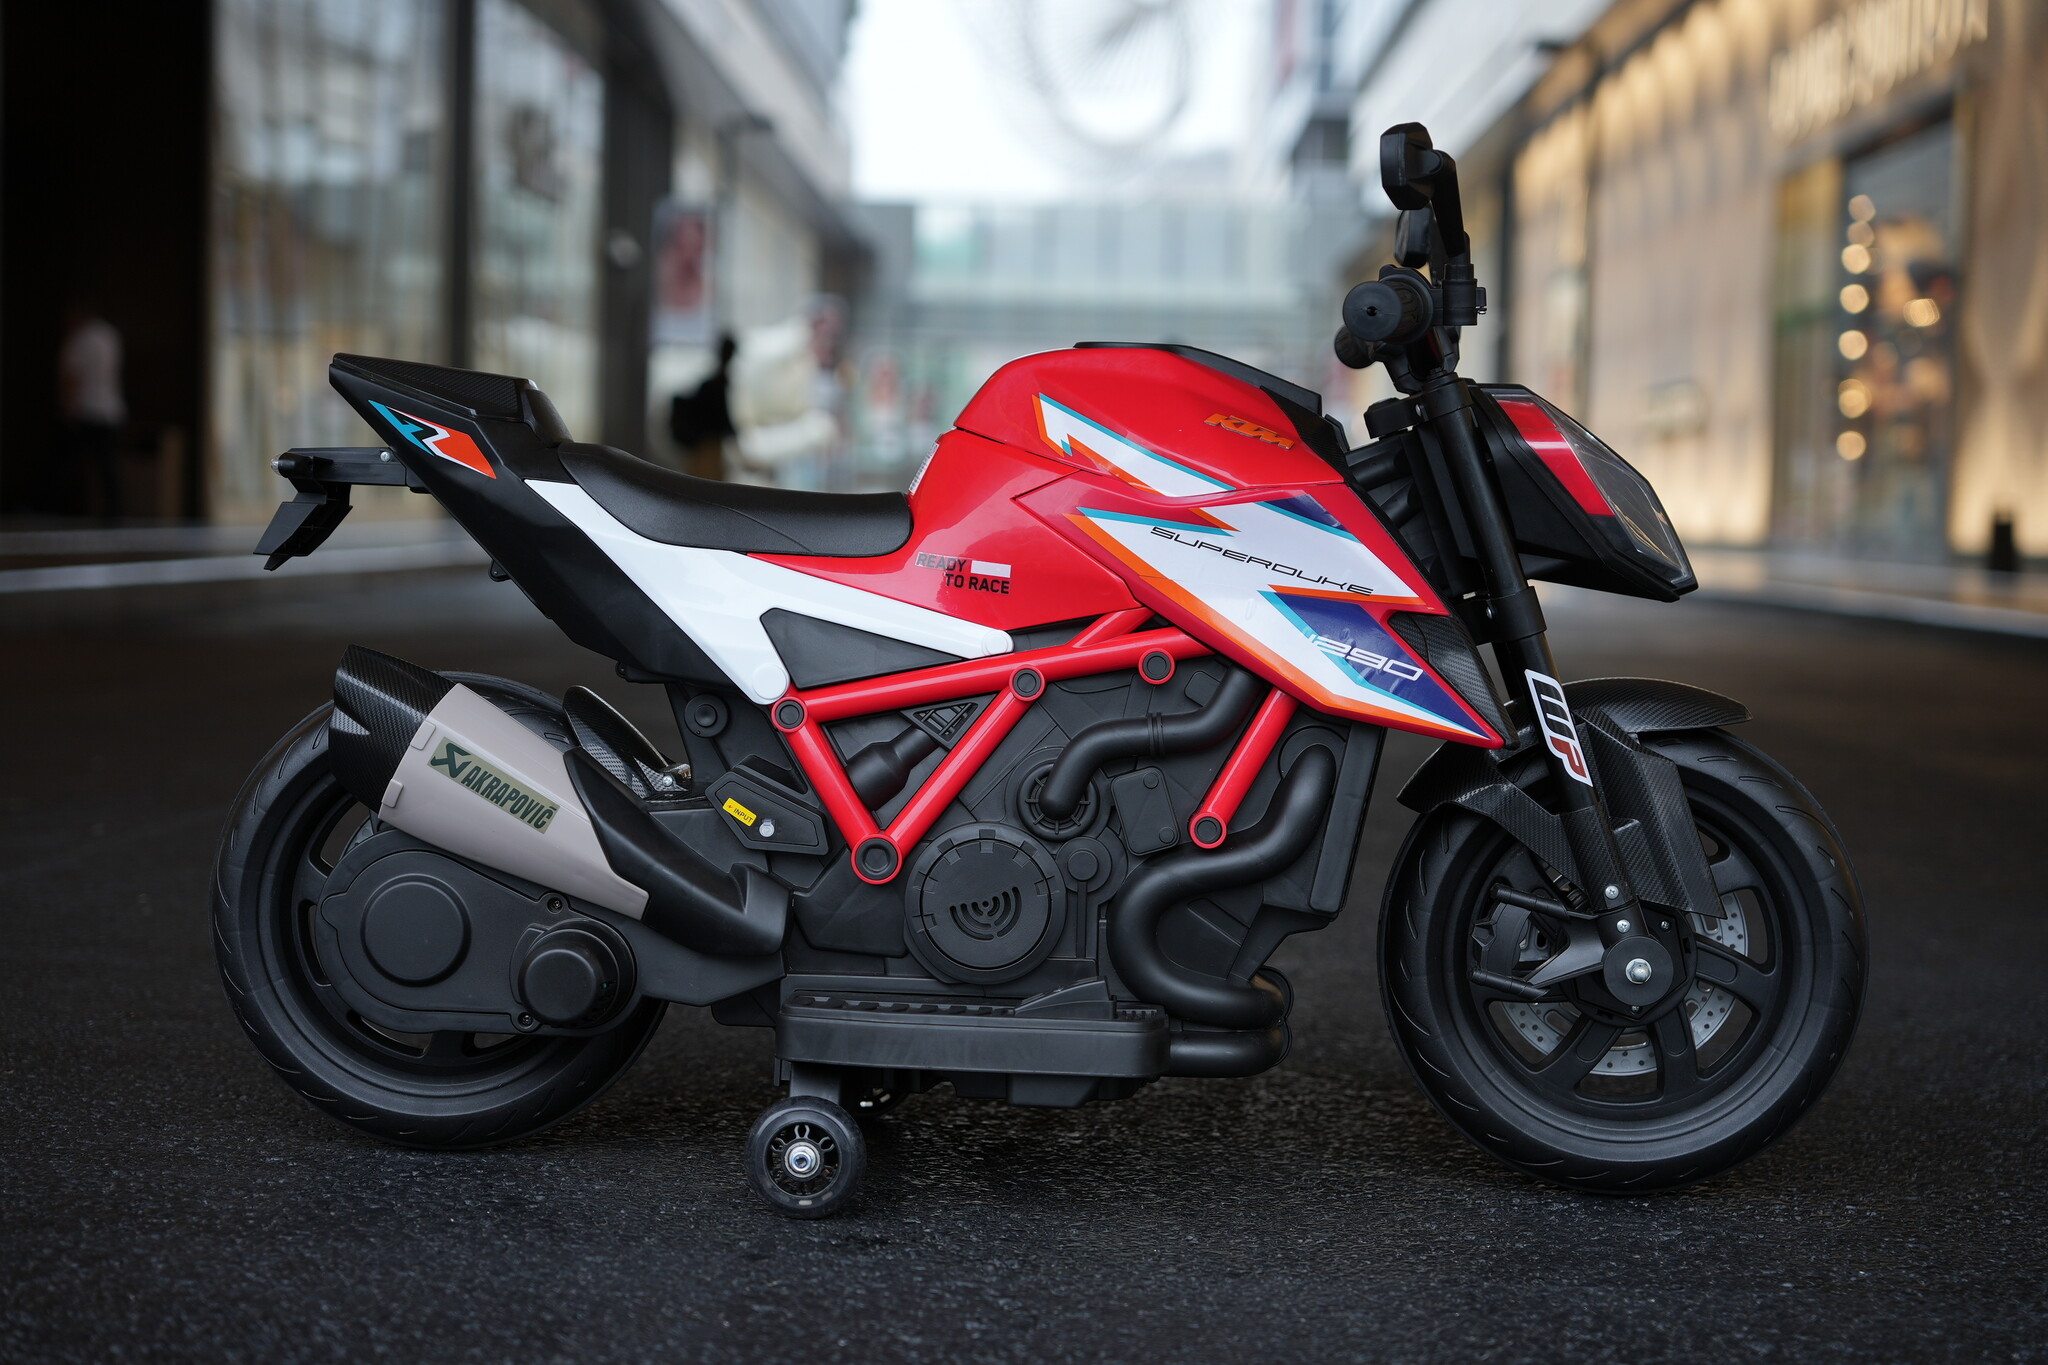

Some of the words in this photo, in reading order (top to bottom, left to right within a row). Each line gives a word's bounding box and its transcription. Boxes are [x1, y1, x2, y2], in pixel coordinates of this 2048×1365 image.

[1204, 413, 1295, 450] KTM
[916, 553, 966, 572] READY
[1150, 526, 1374, 596] SUPERDUKE
[945, 573, 964, 587] TO
[968, 576, 1010, 595] RACE
[733, 807, 754, 824] INPUT
